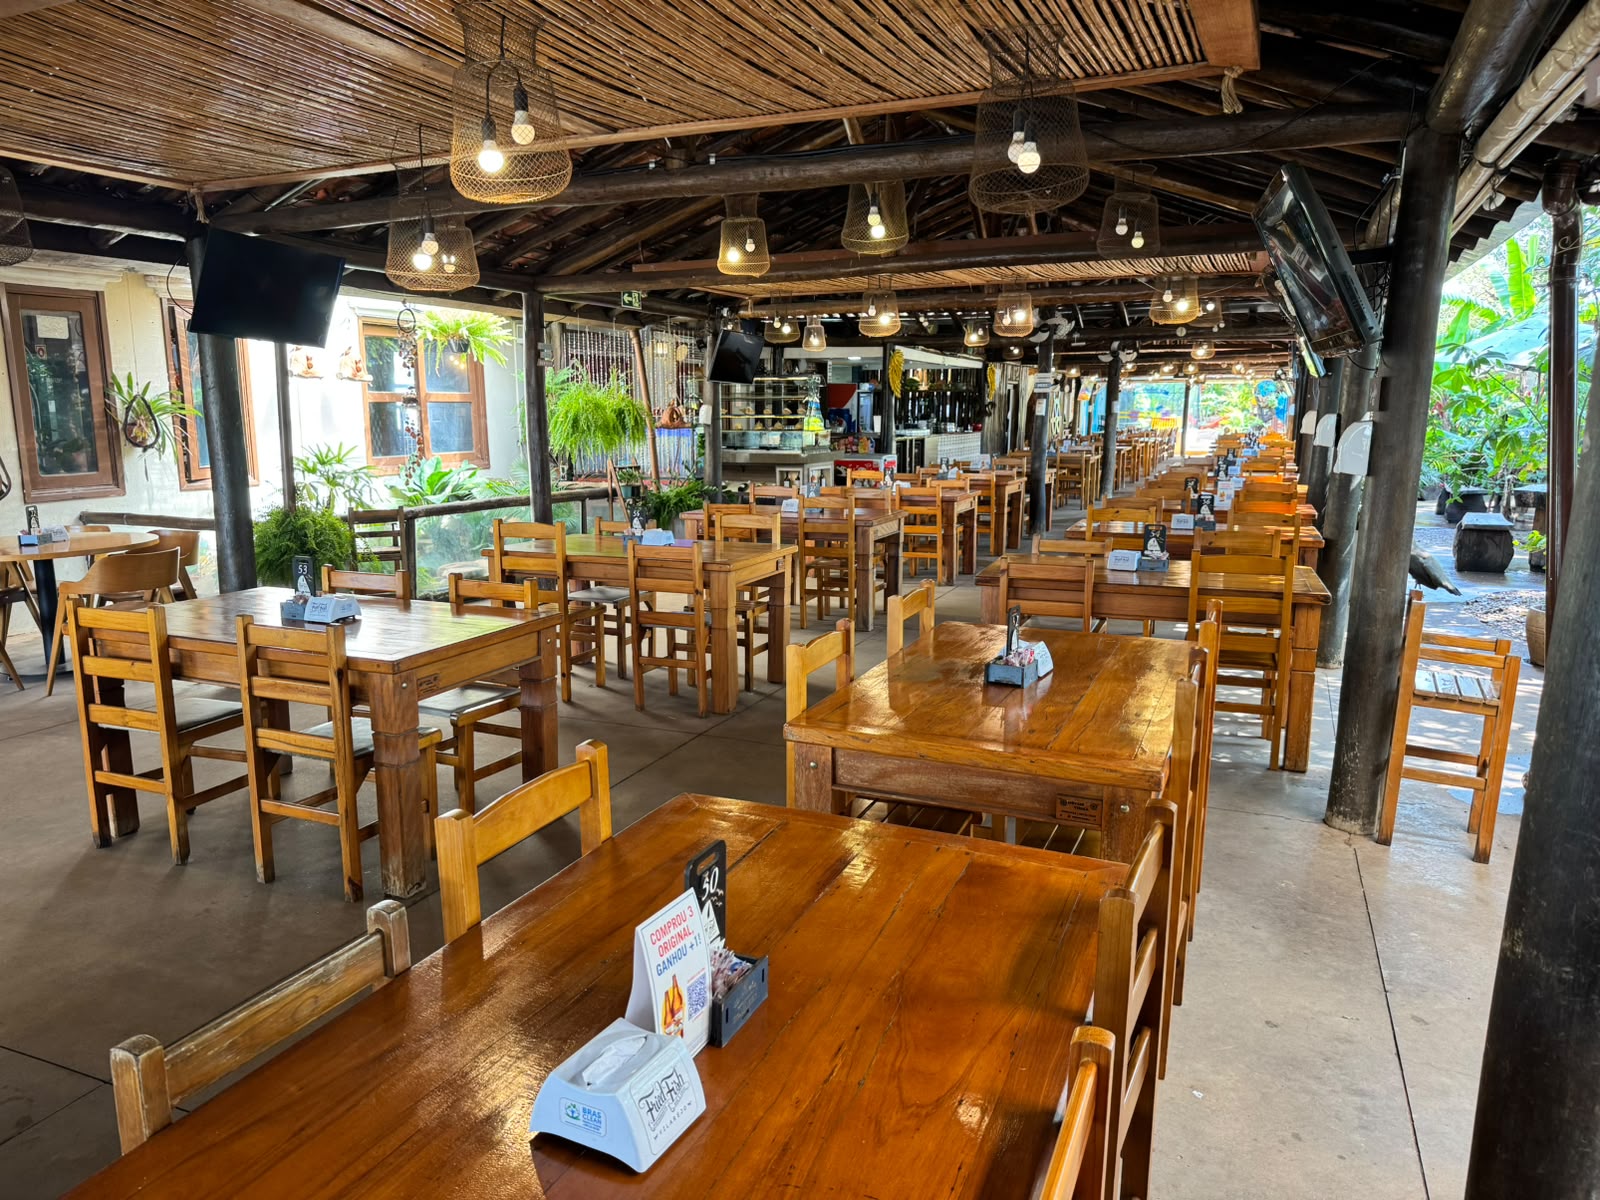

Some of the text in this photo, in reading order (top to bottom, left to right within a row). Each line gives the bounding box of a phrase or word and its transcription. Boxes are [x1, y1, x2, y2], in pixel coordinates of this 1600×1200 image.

[298, 564, 308, 575] 53
[702, 866, 719, 901] 50
[650, 910, 688, 945] COMPROU
[687, 905, 695, 918] 3
[656, 944, 688, 977] GANHOU
[660, 1067, 686, 1103] Fish
[582, 1106, 602, 1119] BRAS
